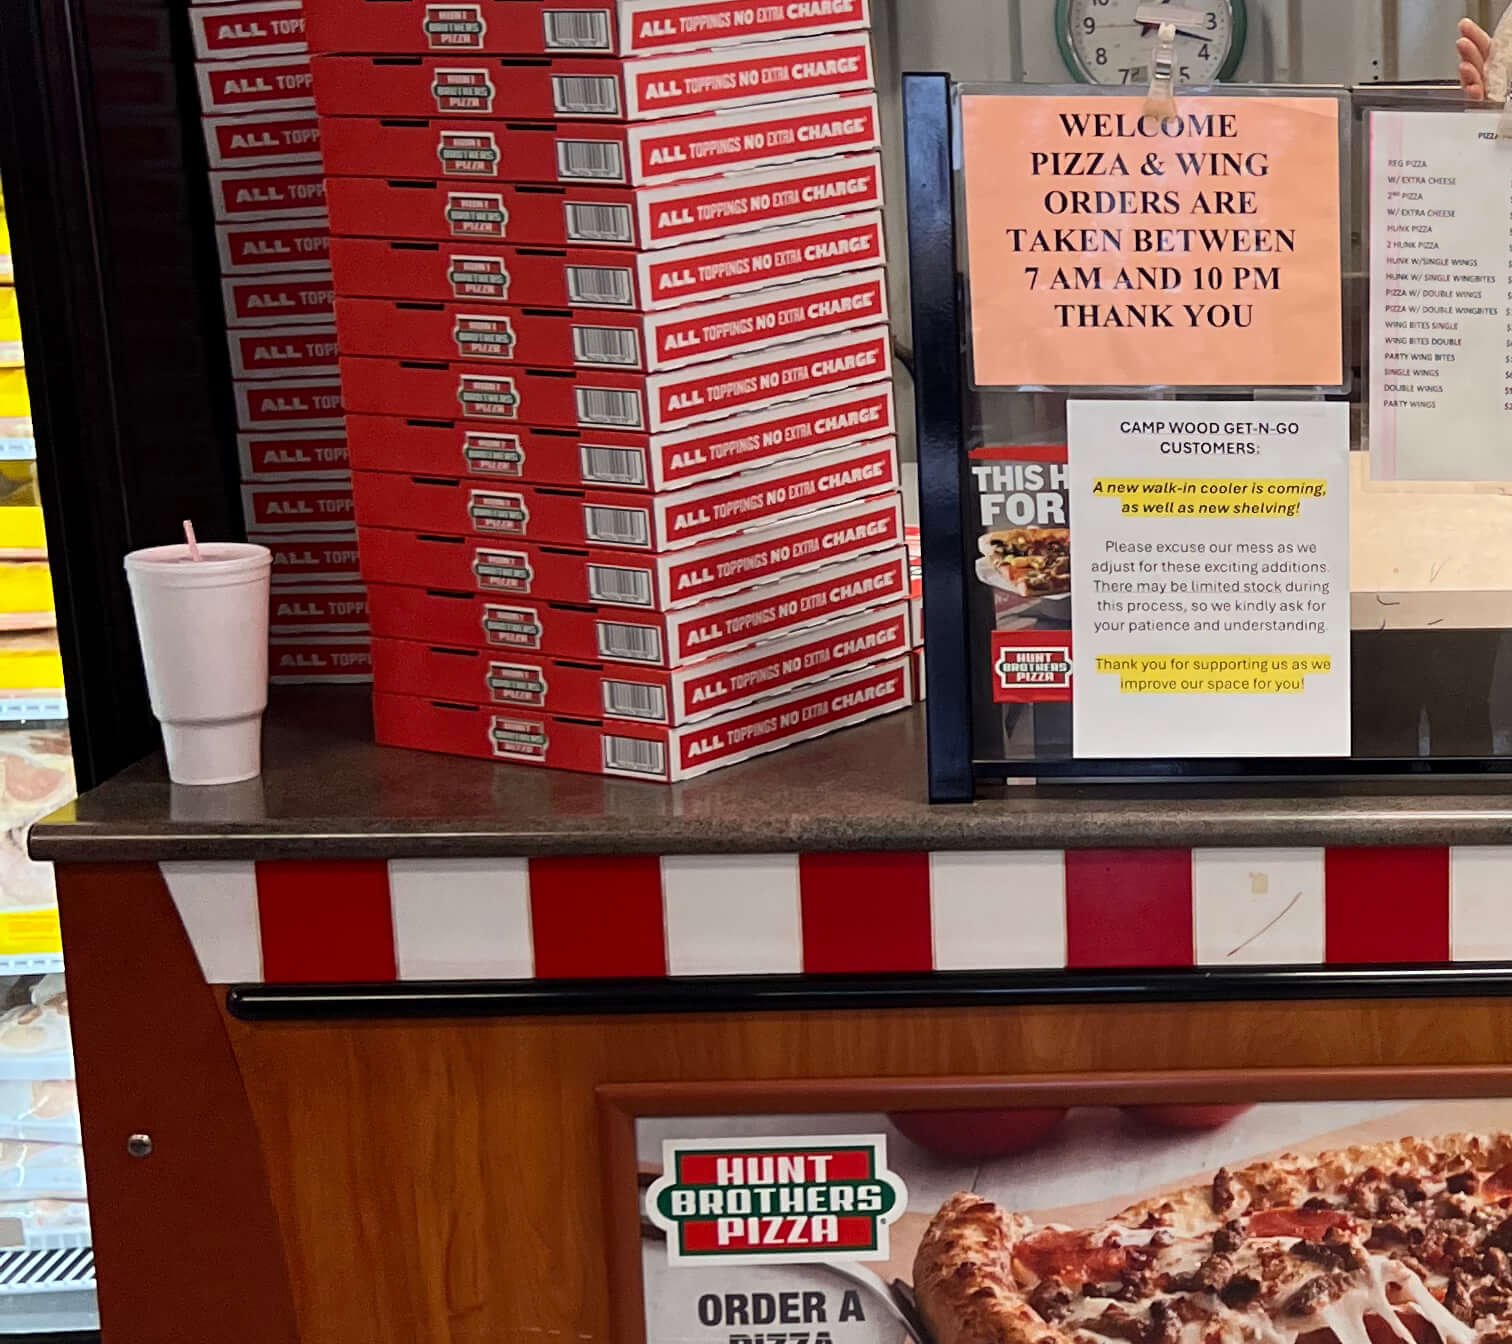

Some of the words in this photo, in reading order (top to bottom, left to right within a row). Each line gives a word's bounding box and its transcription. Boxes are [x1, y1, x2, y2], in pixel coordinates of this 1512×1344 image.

[1059, 113, 1238, 138] WELCOME
[1031, 153, 1129, 176] PIZZA
[1141, 154, 1165, 176] &
[1179, 153, 1269, 176] WING
[1044, 191, 1180, 214] ORDERS
[1190, 192, 1258, 214] ARE
[1007, 229, 1121, 252] TAKEN
[1133, 230, 1295, 252] BETWEEN
[1025, 267, 1038, 290] 7
[1050, 267, 1103, 290] AM
[1112, 267, 1181, 290] AND
[1195, 267, 1222, 290] 10
[1234, 267, 1280, 290] PM
[1054, 304, 1173, 327] THANK
[1184, 305, 1253, 328] YOU
[1120, 422, 1165, 434] CAMP
[1169, 422, 1220, 434] WOOD
[1224, 422, 1299, 435] GET-N-GO
[1160, 442, 1260, 454] CUSTOMERS:
[972, 465, 1044, 491] THIS
[1093, 481, 1104, 493] A
[1107, 483, 1139, 494] new
[1142, 481, 1196, 495] walk-in
[1200, 482, 1248, 495] cooler
[1252, 483, 1263, 495] is
[1267, 483, 1327, 497] coming,
[980, 493, 1065, 525] FOR
[1121, 503, 1139, 514] as
[1142, 501, 1174, 514] well
[1179, 503, 1195, 514] as
[1199, 503, 1229, 514] new
[1233, 501, 1300, 516] shelving!
[1105, 541, 1152, 554] Please
[1156, 542, 1205, 554] excuse
[1209, 543, 1232, 554] our
[1236, 543, 1273, 554] mess
[1277, 543, 1293, 554] as
[1296, 543, 1317, 554] we
[1001, 662, 1068, 672] BROTHERS
[1017, 652, 1052, 663] HUNT
[1017, 672, 1054, 682] PIZZA
[717, 1155, 832, 1184] HUNT
[670, 1185, 883, 1216] BROTHERS
[717, 1215, 840, 1245] PIZZA
[700, 1292, 826, 1327] ORDER
[839, 1292, 865, 1321] A
